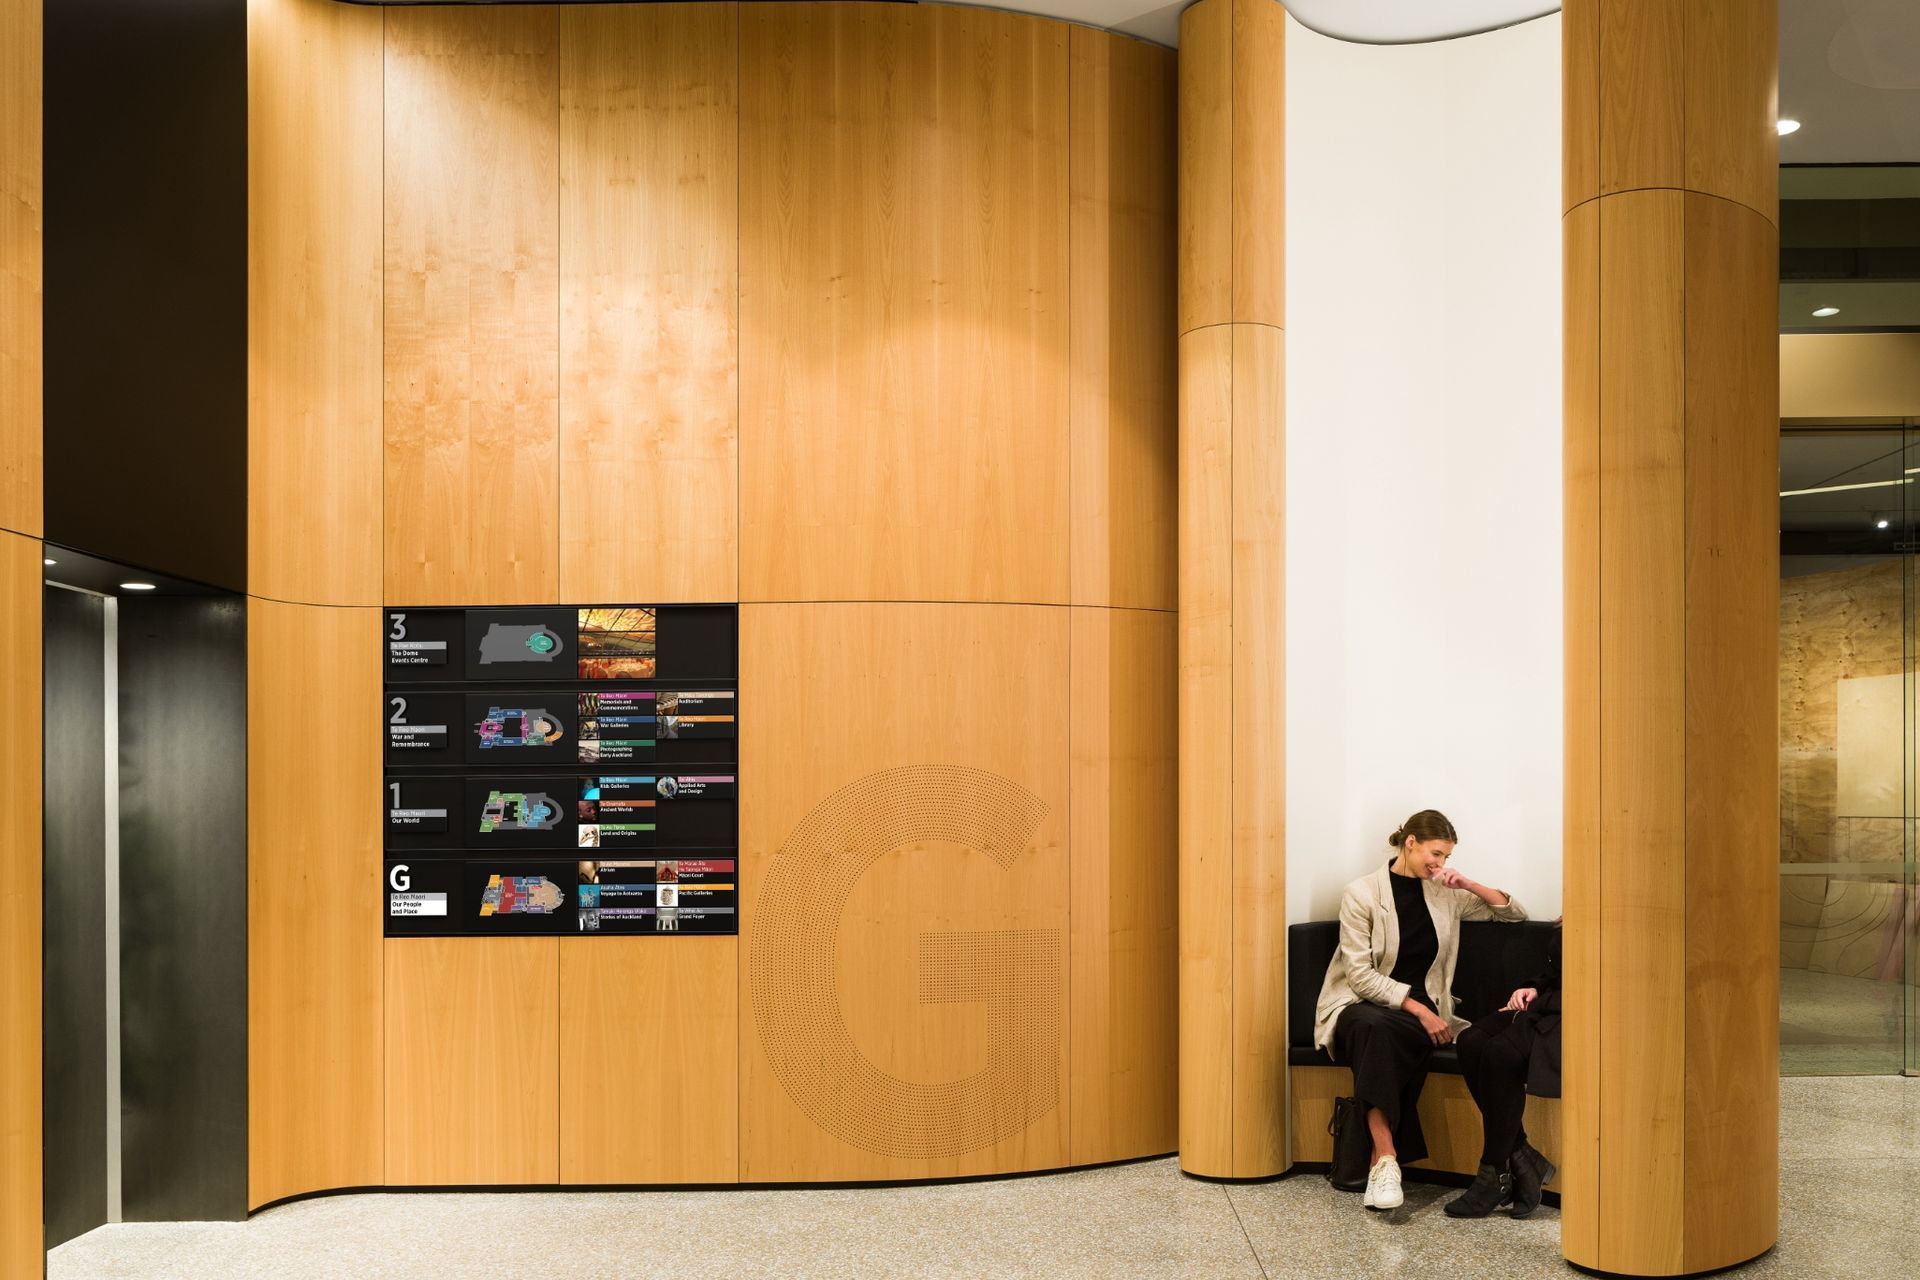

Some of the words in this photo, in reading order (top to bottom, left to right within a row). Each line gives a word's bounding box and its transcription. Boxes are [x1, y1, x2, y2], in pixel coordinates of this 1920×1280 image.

[389, 614, 406, 640] 3
[390, 697, 407, 724] 2
[389, 782, 400, 808] 1
[389, 864, 411, 892] G
[749, 764, 1064, 1160] G
